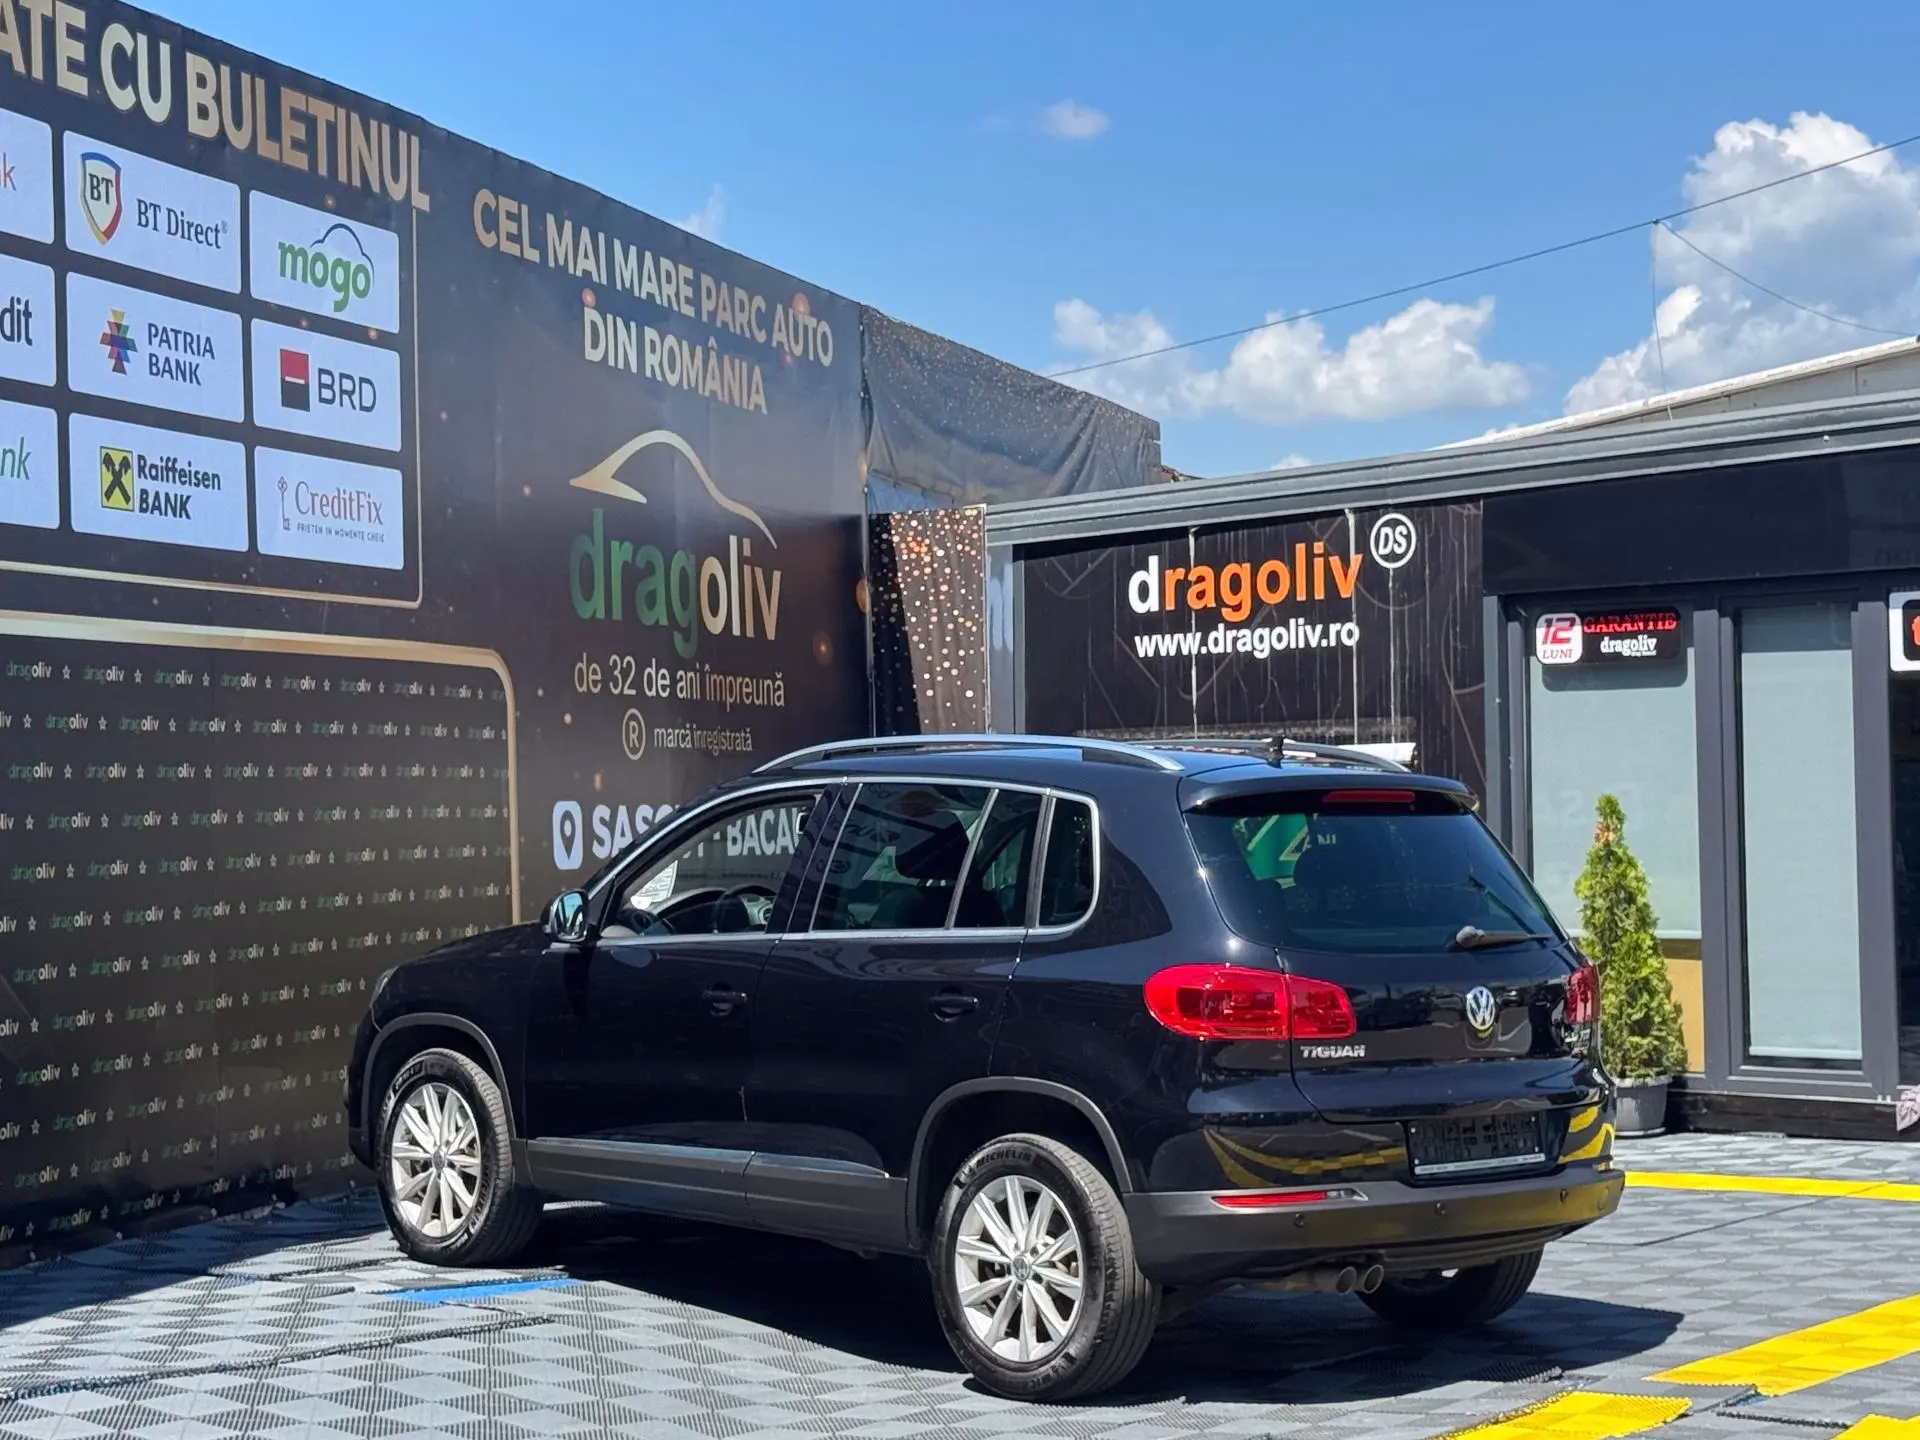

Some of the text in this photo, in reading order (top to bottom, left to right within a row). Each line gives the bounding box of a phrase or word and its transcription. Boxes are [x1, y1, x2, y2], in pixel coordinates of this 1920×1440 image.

[101, 22, 172, 124] CU
[185, 51, 430, 212] BULETINUL
[88, 174, 114, 205] BT
[136, 199, 162, 230] BT
[279, 241, 371, 312] mogo
[473, 188, 833, 366] CEL MAI MARE PARC AUTO
[147, 322, 216, 360] PATRIA
[148, 356, 202, 386] BANK
[583, 306, 768, 415] DIN ROMÂNIA
[318, 369, 377, 413] BRD
[137, 454, 221, 491] Raiffeisen
[139, 490, 192, 521] BANK
[295, 481, 383, 526] CreditFix
[1378, 526, 1409, 555] DS
[569, 508, 782, 658] dragoliv
[1128, 541, 1363, 622] dragoliv
[1134, 617, 1361, 659] www.dragoliv.ro
[1542, 617, 1577, 645] 12
[1600, 633, 1658, 656] dragoliv
[1542, 648, 1574, 660] LUNI
[574, 653, 785, 712] de 32 de ani împreună
[653, 722, 692, 749] marcă
[1301, 1045, 1366, 1059] TIGUAN
[976, 1149, 1031, 1168] MICHELIN
